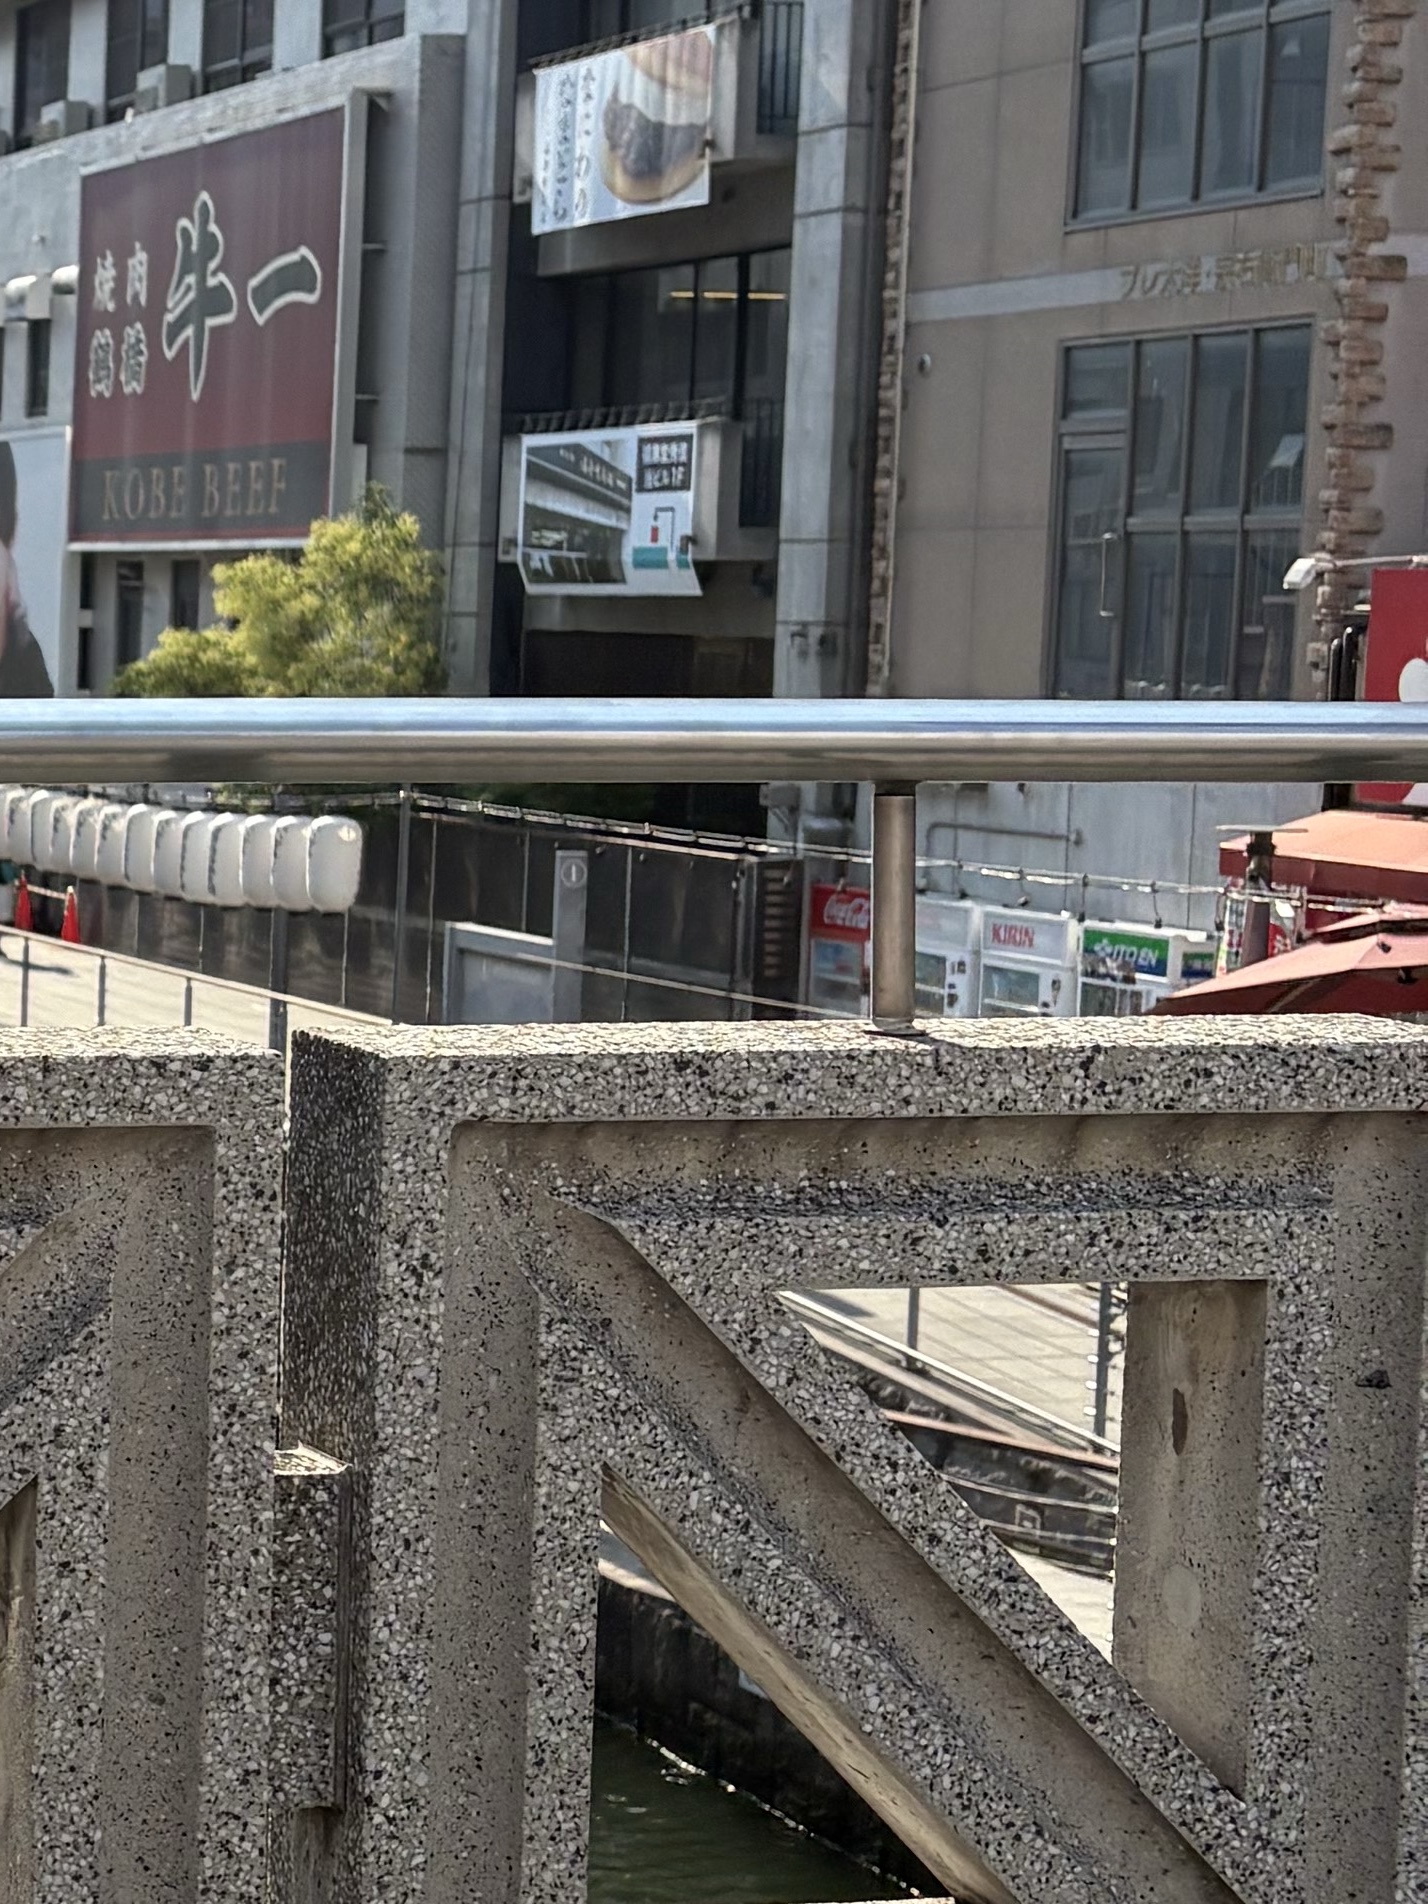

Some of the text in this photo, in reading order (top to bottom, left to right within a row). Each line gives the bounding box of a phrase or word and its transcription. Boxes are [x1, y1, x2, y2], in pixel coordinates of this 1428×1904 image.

[163, 190, 323, 403] 牛一
[102, 457, 288, 522] KOBE BEEF
[991, 922, 1035, 948] KIRIN
